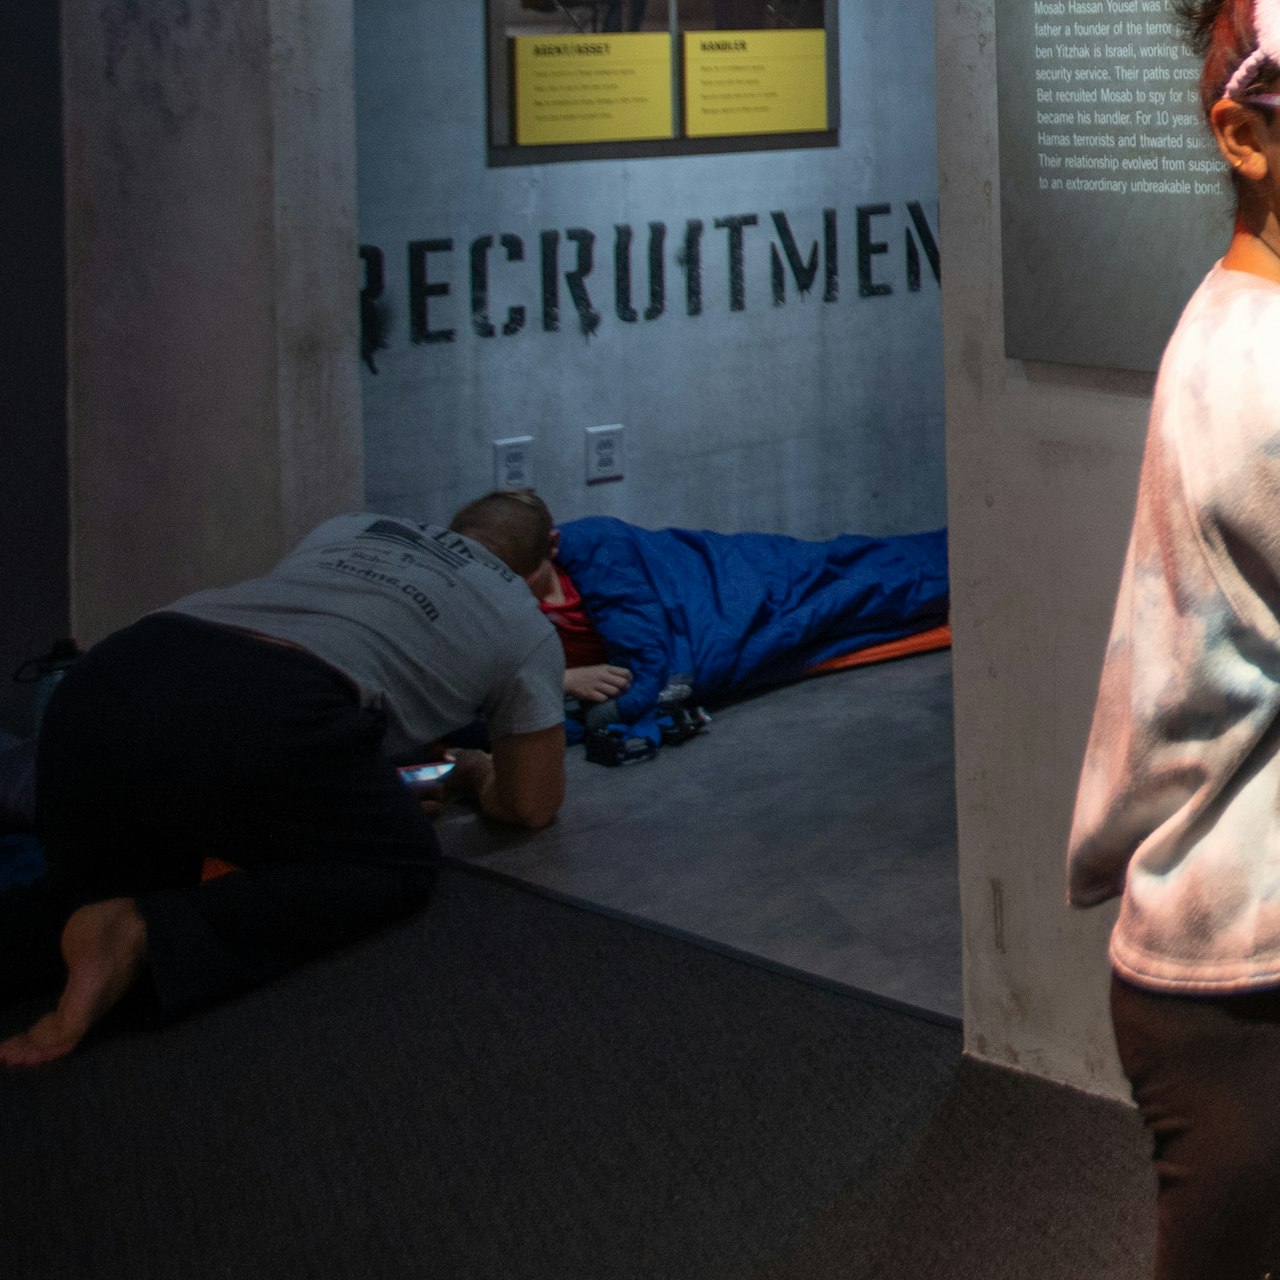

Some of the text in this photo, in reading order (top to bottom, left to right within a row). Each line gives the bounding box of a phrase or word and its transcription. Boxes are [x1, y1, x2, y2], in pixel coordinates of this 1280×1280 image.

[1039, 177, 1223, 194] to an extraordinary unbreakable bond.
